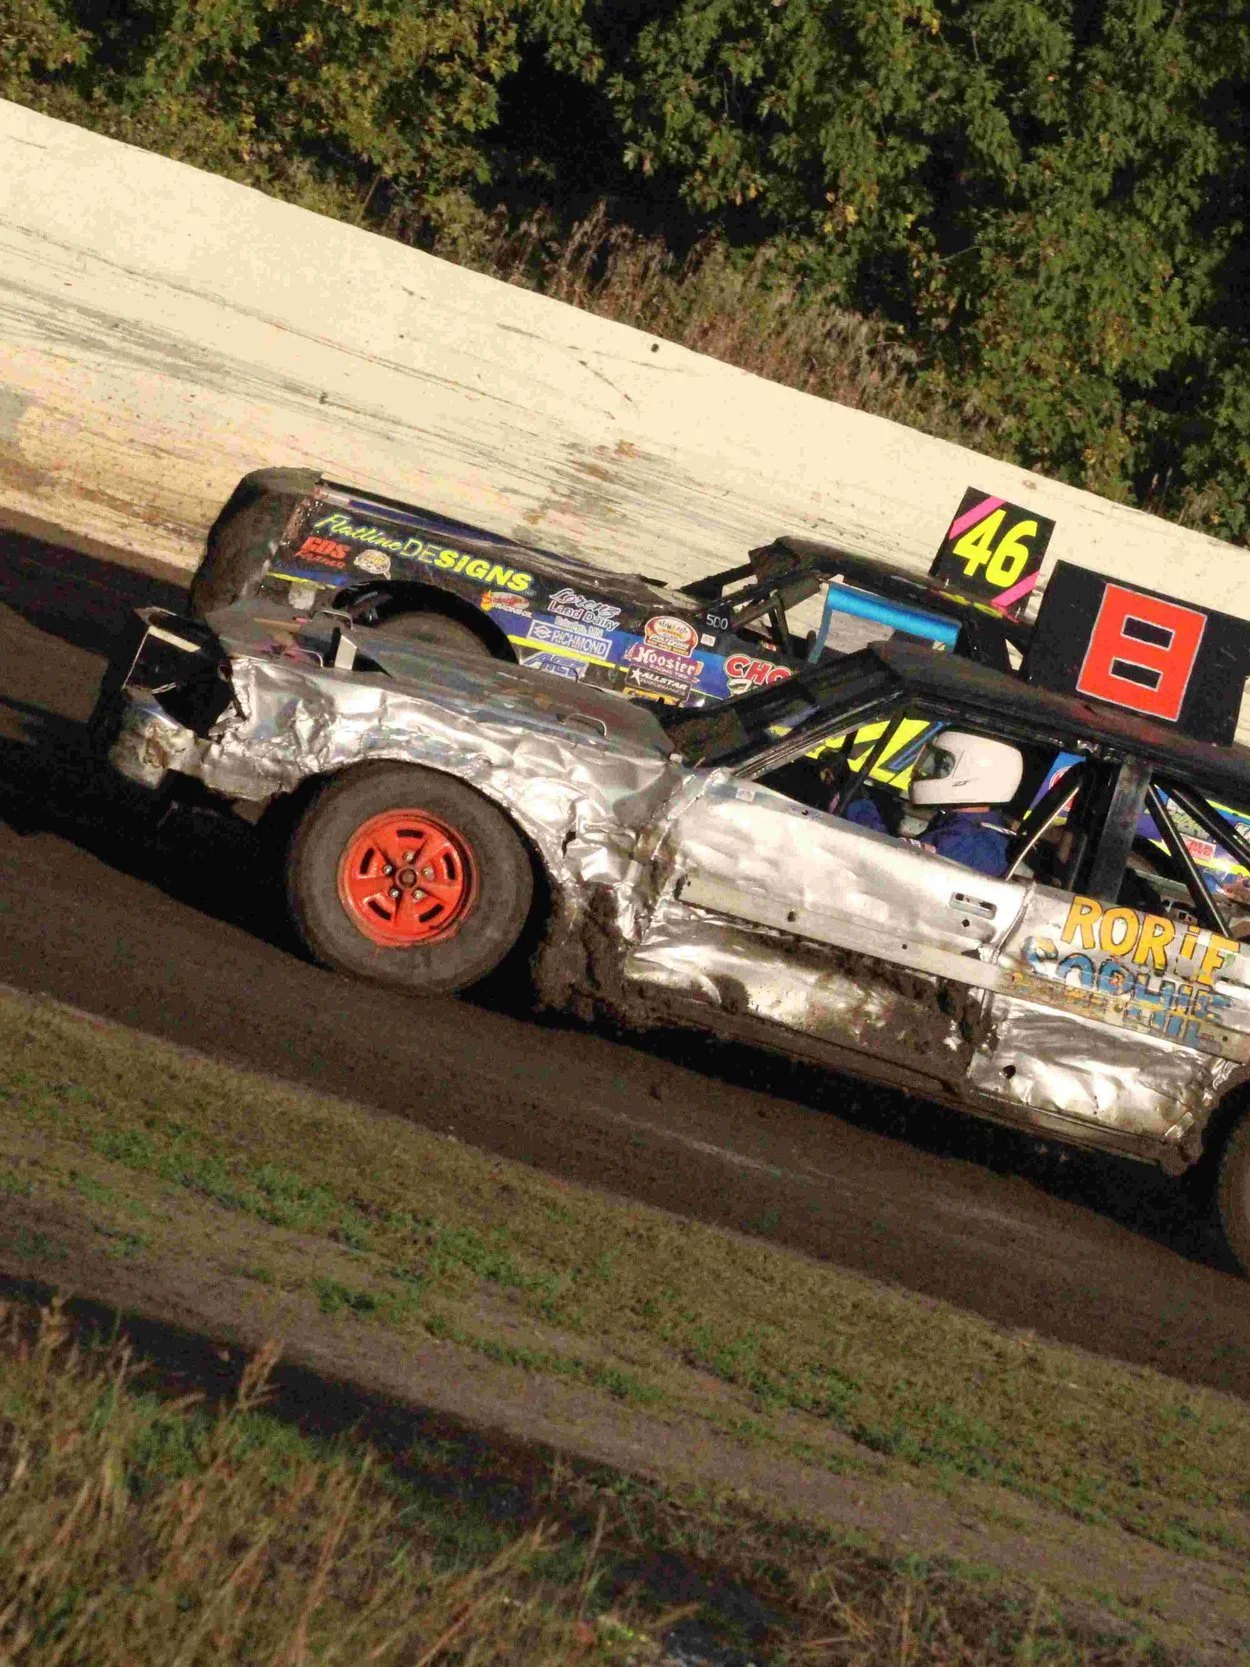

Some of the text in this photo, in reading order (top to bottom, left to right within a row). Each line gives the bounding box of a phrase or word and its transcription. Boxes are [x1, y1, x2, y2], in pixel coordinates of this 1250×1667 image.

[953, 509, 1038, 588] 46
[547, 600, 585, 620] Land
[582, 610, 620, 632] Dairy
[551, 630, 606, 658] RICHMOND
[1075, 582, 1208, 723] 8
[631, 647, 696, 676] Hoosier
[641, 672, 689, 691] ALLSTAR
